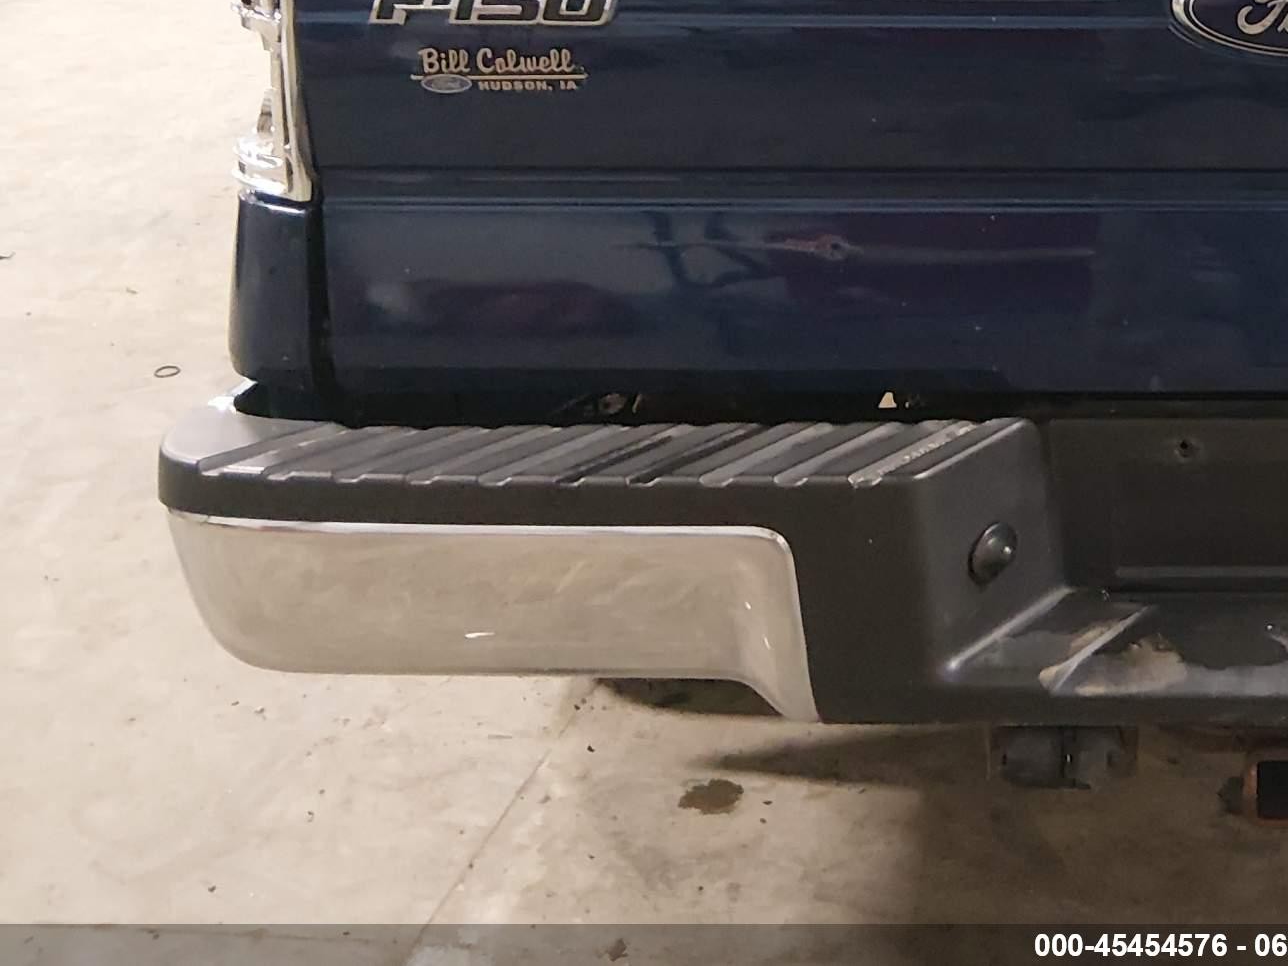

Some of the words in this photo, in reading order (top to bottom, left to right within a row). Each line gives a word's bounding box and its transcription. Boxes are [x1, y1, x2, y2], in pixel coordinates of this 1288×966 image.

[418, 47, 470, 73] Bill
[477, 80, 553, 91] HUDSON,
[559, 80, 577, 91] IA
